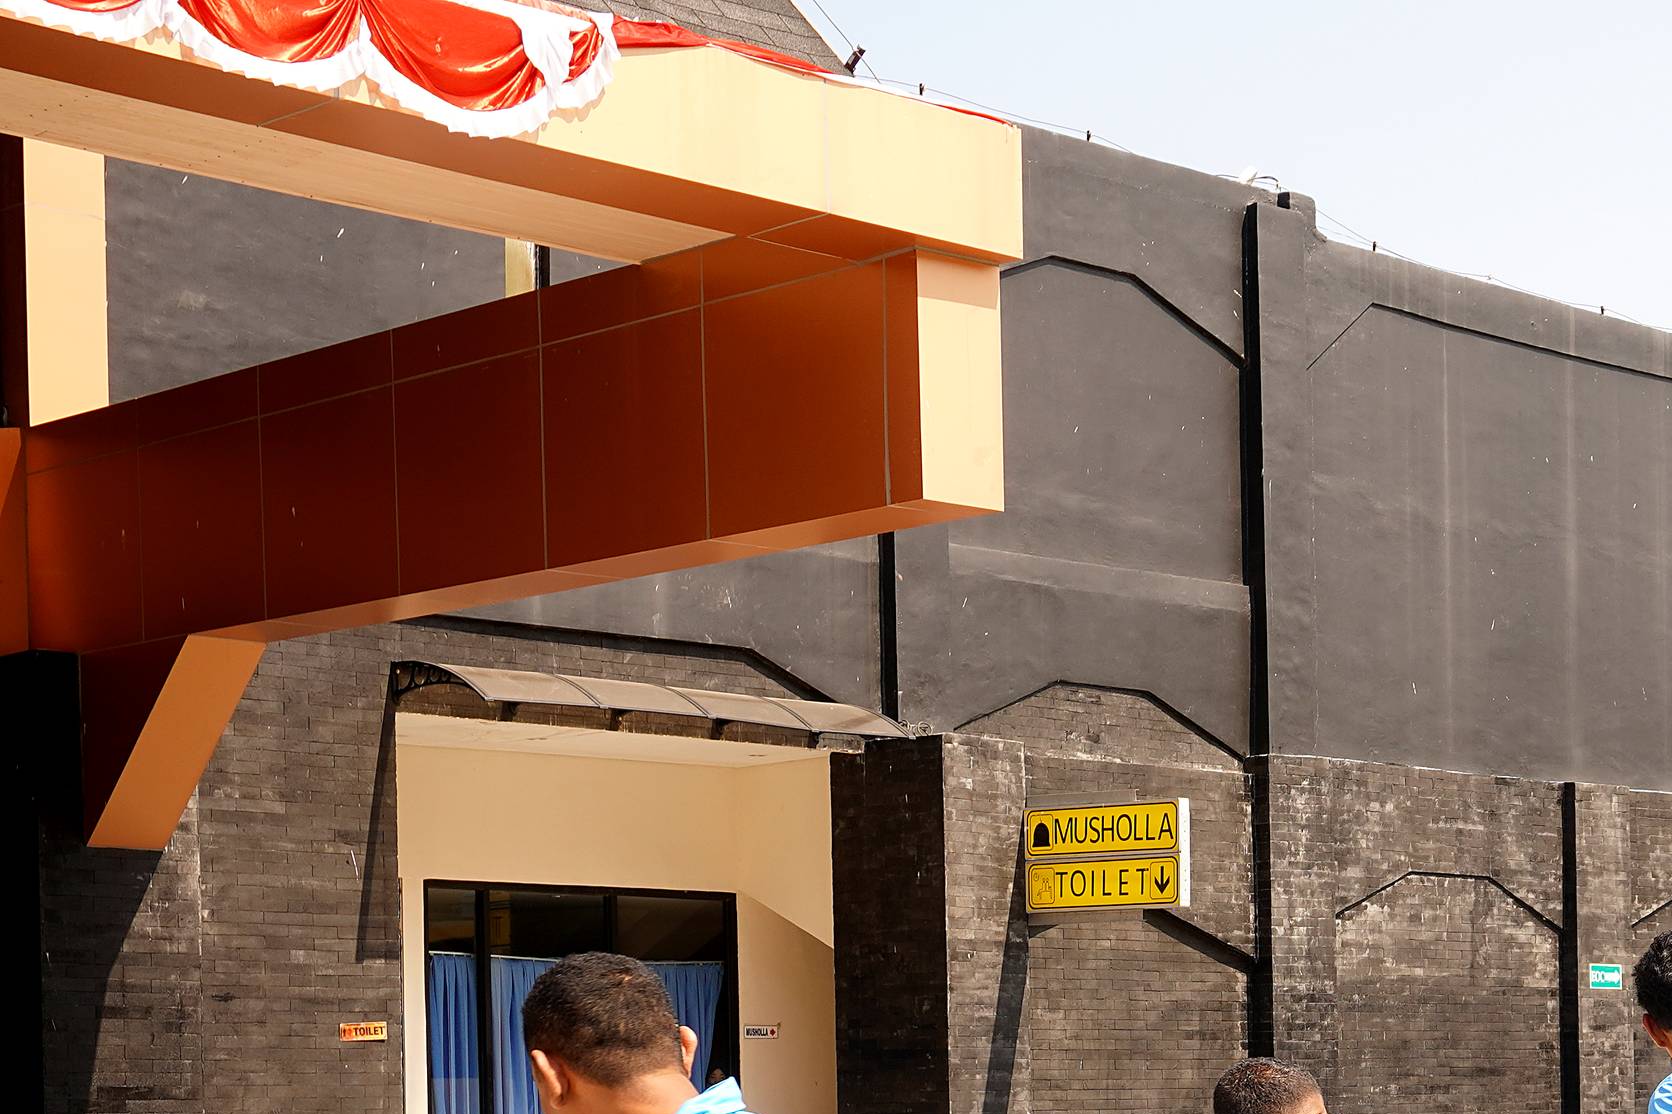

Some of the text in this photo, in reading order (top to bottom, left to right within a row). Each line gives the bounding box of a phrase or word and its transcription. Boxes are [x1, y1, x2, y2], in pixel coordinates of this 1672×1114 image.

[1054, 813, 1174, 844] MUSHOLLA
[1056, 868, 1149, 898] TOILET
[353, 1026, 385, 1036] TOILET
